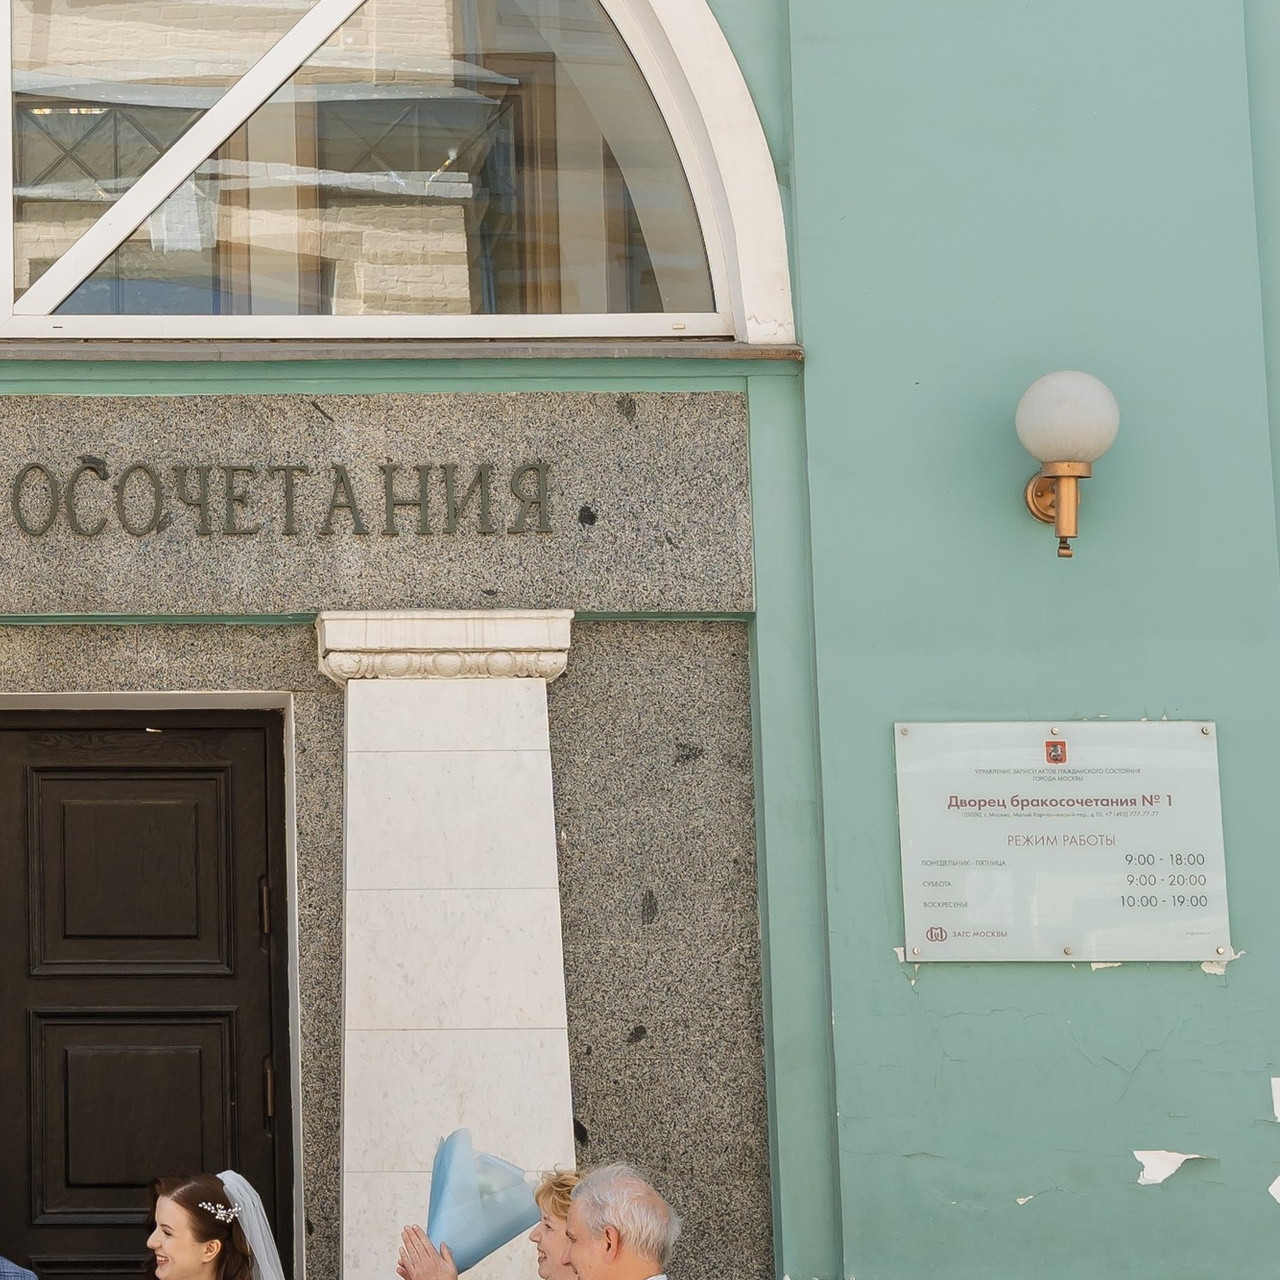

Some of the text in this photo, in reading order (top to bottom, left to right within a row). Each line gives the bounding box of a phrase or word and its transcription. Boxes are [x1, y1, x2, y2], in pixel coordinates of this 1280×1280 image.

[947, 794, 1173, 811] Дворец бракосочетания № 1
[1007, 834, 1116, 847] РЕЖИМ РАБОТЫ
[1124, 853, 1155, 866] 9:00
[1169, 853, 1205, 866] 18:00
[1126, 874, 1157, 886] 9:00
[1168, 874, 1206, 886] 20:00
[1121, 895, 1158, 907] 10:00
[1172, 895, 1208, 907] 19:00
